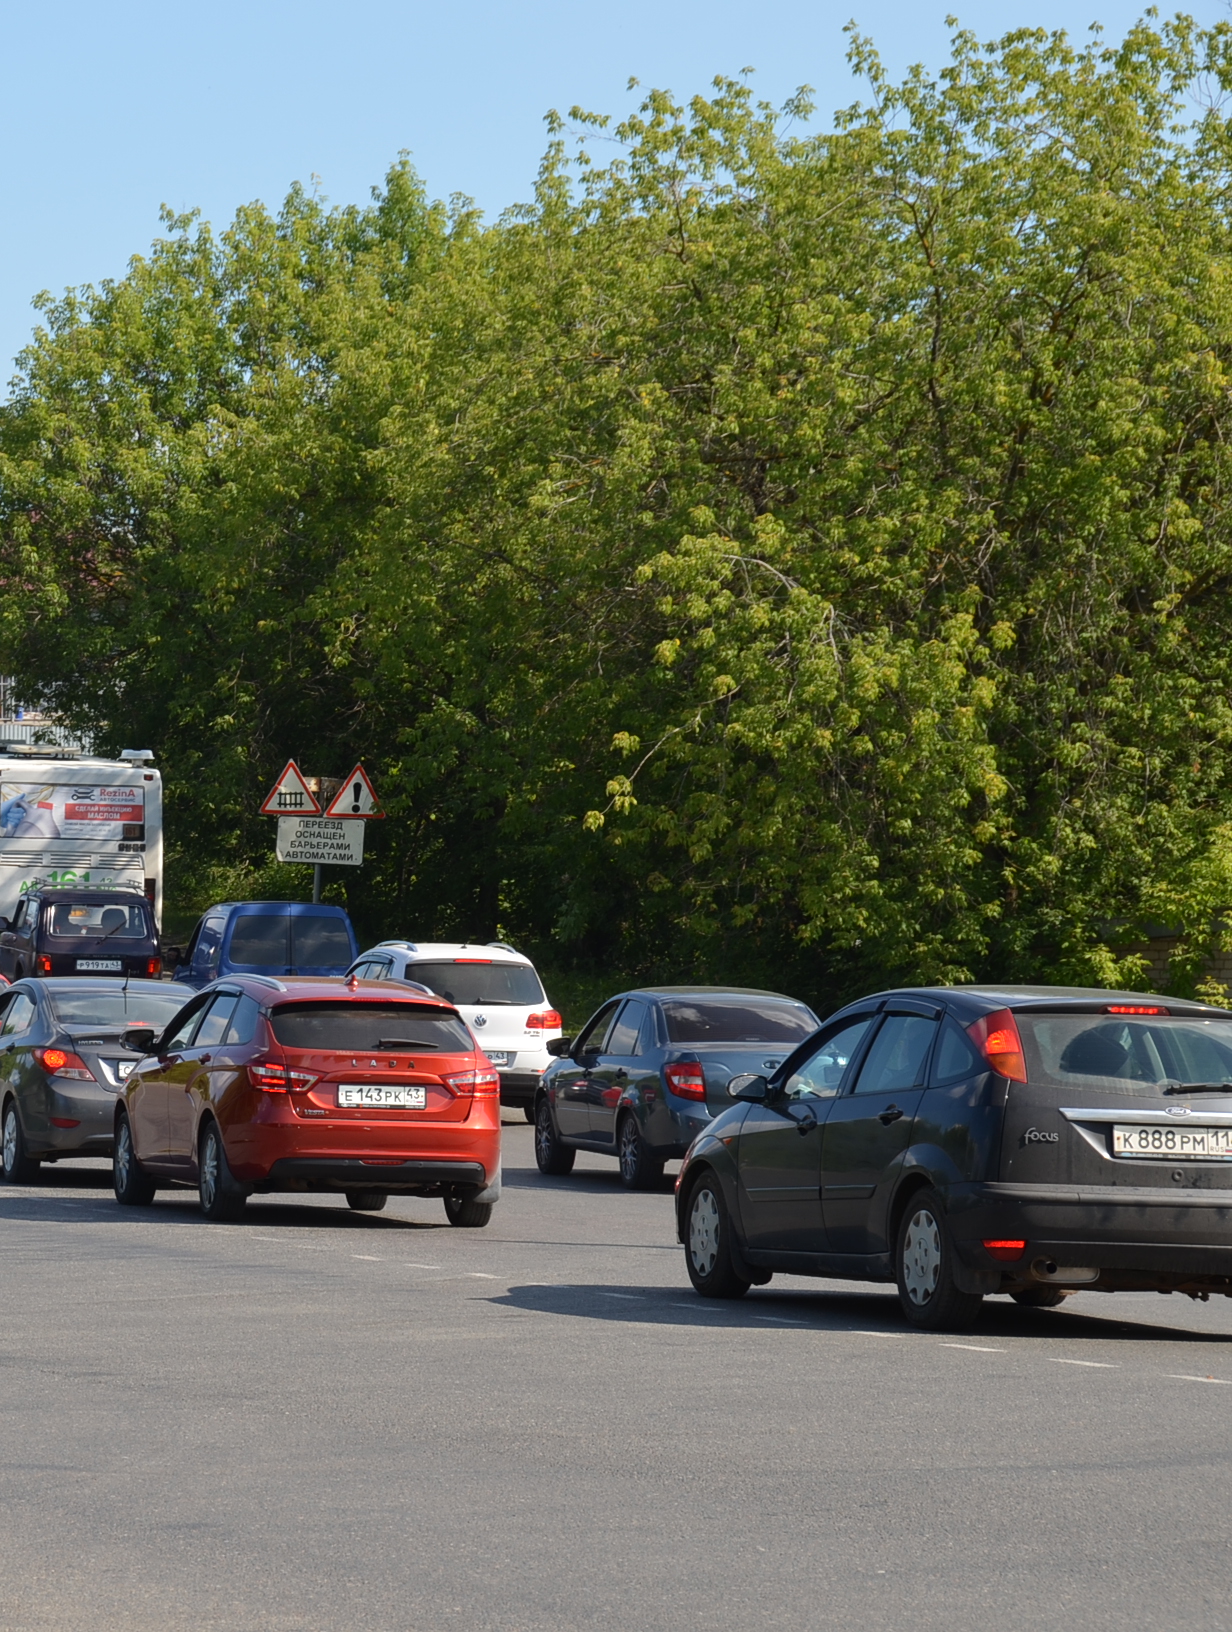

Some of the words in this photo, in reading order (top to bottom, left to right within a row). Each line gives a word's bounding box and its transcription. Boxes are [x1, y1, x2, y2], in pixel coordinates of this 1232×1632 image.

[100, 788, 136, 797] RezinA
[298, 820, 343, 830] ПЕРЕЕЗД
[295, 831, 346, 840] ОСНАЩЕН
[290, 841, 351, 850] БАРЬЕРАМИ
[285, 851, 353, 861] АВТОМАТАМИ
[46, 870, 91, 890] 161
[79, 961, 110, 969] Р919ТА
[351, 1059, 416, 1069] LADA
[345, 1087, 402, 1102] Е143РК
[406, 1088, 420, 1099] 43
[1023, 1127, 1060, 1145] focus
[1123, 1129, 1206, 1152] К888РМ
[1210, 1131, 1232, 1147] 11
